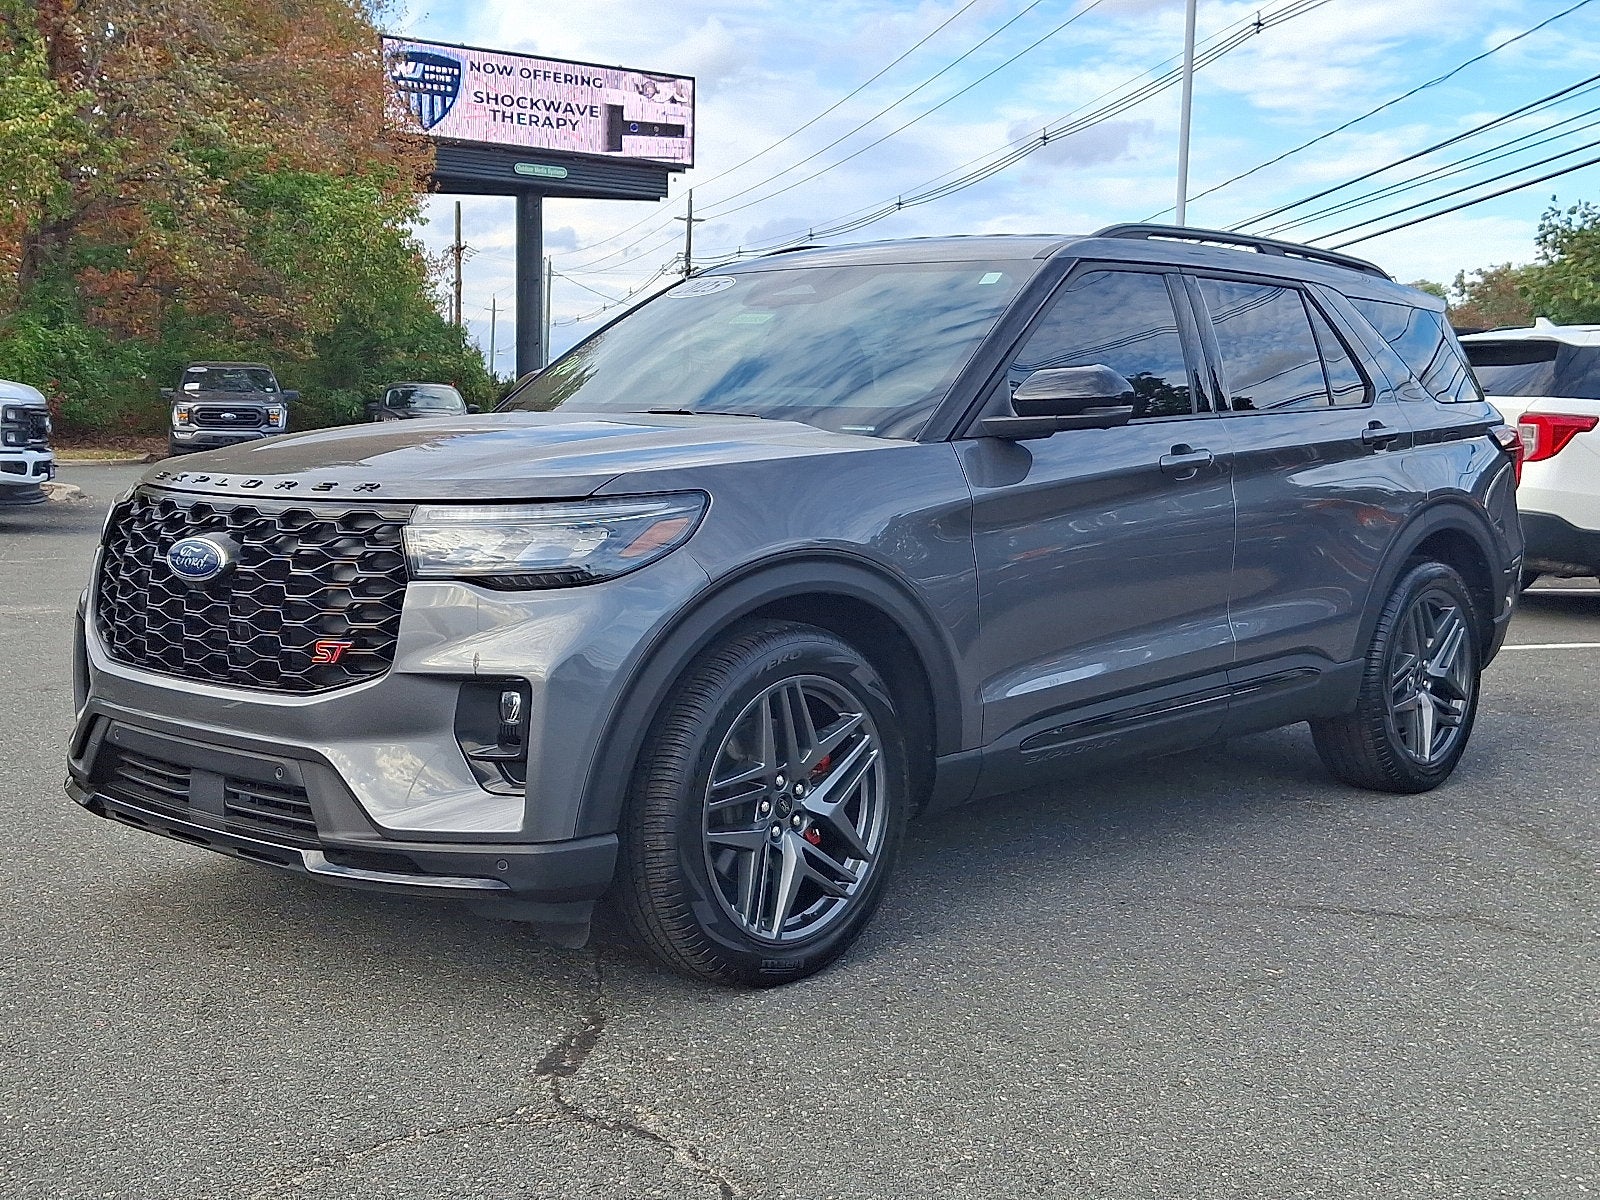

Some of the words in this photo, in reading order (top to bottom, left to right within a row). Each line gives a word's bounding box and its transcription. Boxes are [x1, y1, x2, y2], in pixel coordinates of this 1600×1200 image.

[469, 61, 514, 77] NOW
[519, 67, 603, 89] OFFERING
[473, 90, 600, 119] SHOCKWAVE
[489, 108, 580, 132] THERAPY
[155, 471, 381, 493] EXPLORER
[175, 545, 210, 570] Ford
[311, 640, 354, 664] ST
